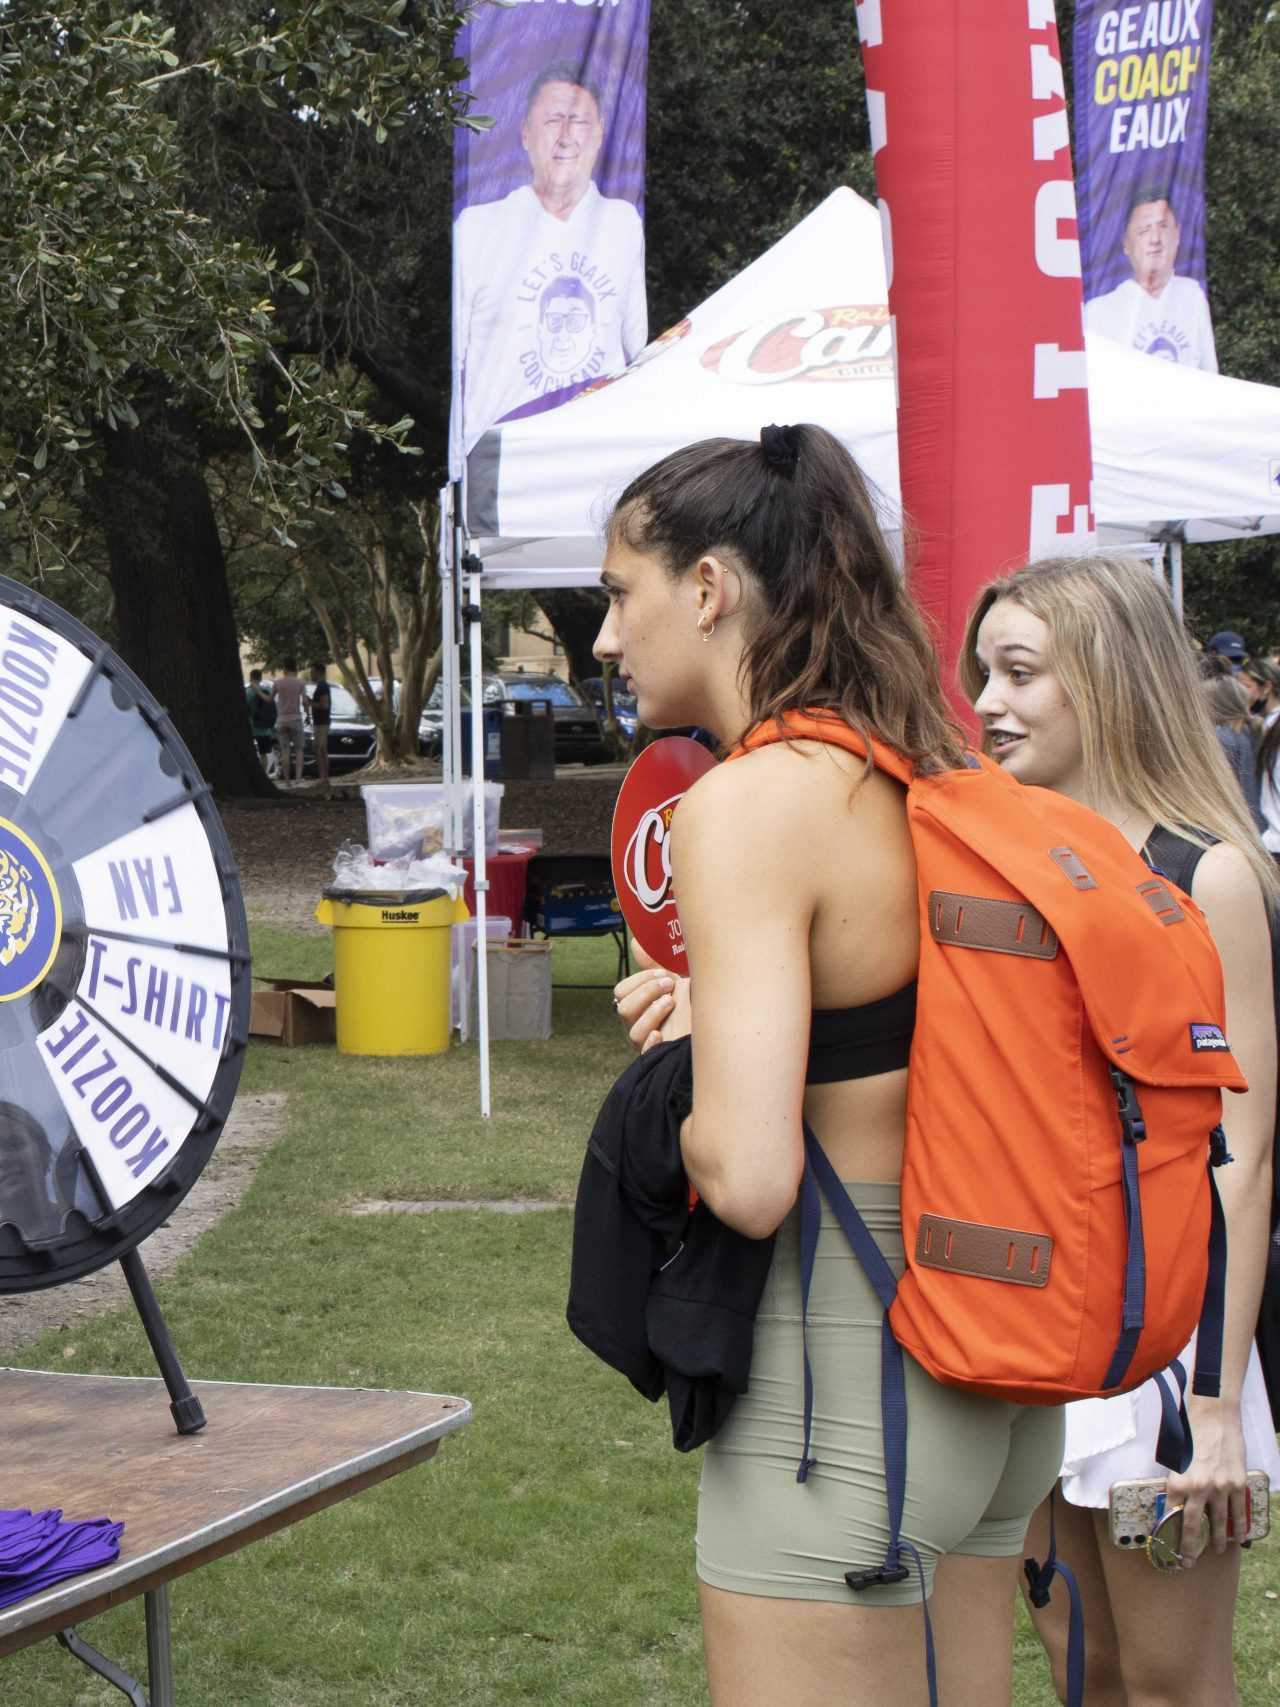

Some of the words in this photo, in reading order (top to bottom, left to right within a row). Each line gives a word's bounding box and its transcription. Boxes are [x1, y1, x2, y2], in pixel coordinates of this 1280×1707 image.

[1095, 0, 1200, 56] GEAUX
[1094, 45, 1200, 105] COACH
[1109, 97, 1190, 153] EAUX
[571, 251, 616, 302] GEAUX
[108, 854, 183, 921] FAN
[381, 909, 419, 922] Huskee
[88, 938, 231, 1050] T-SHIRT
[44, 1009, 169, 1179] KOOZIE
